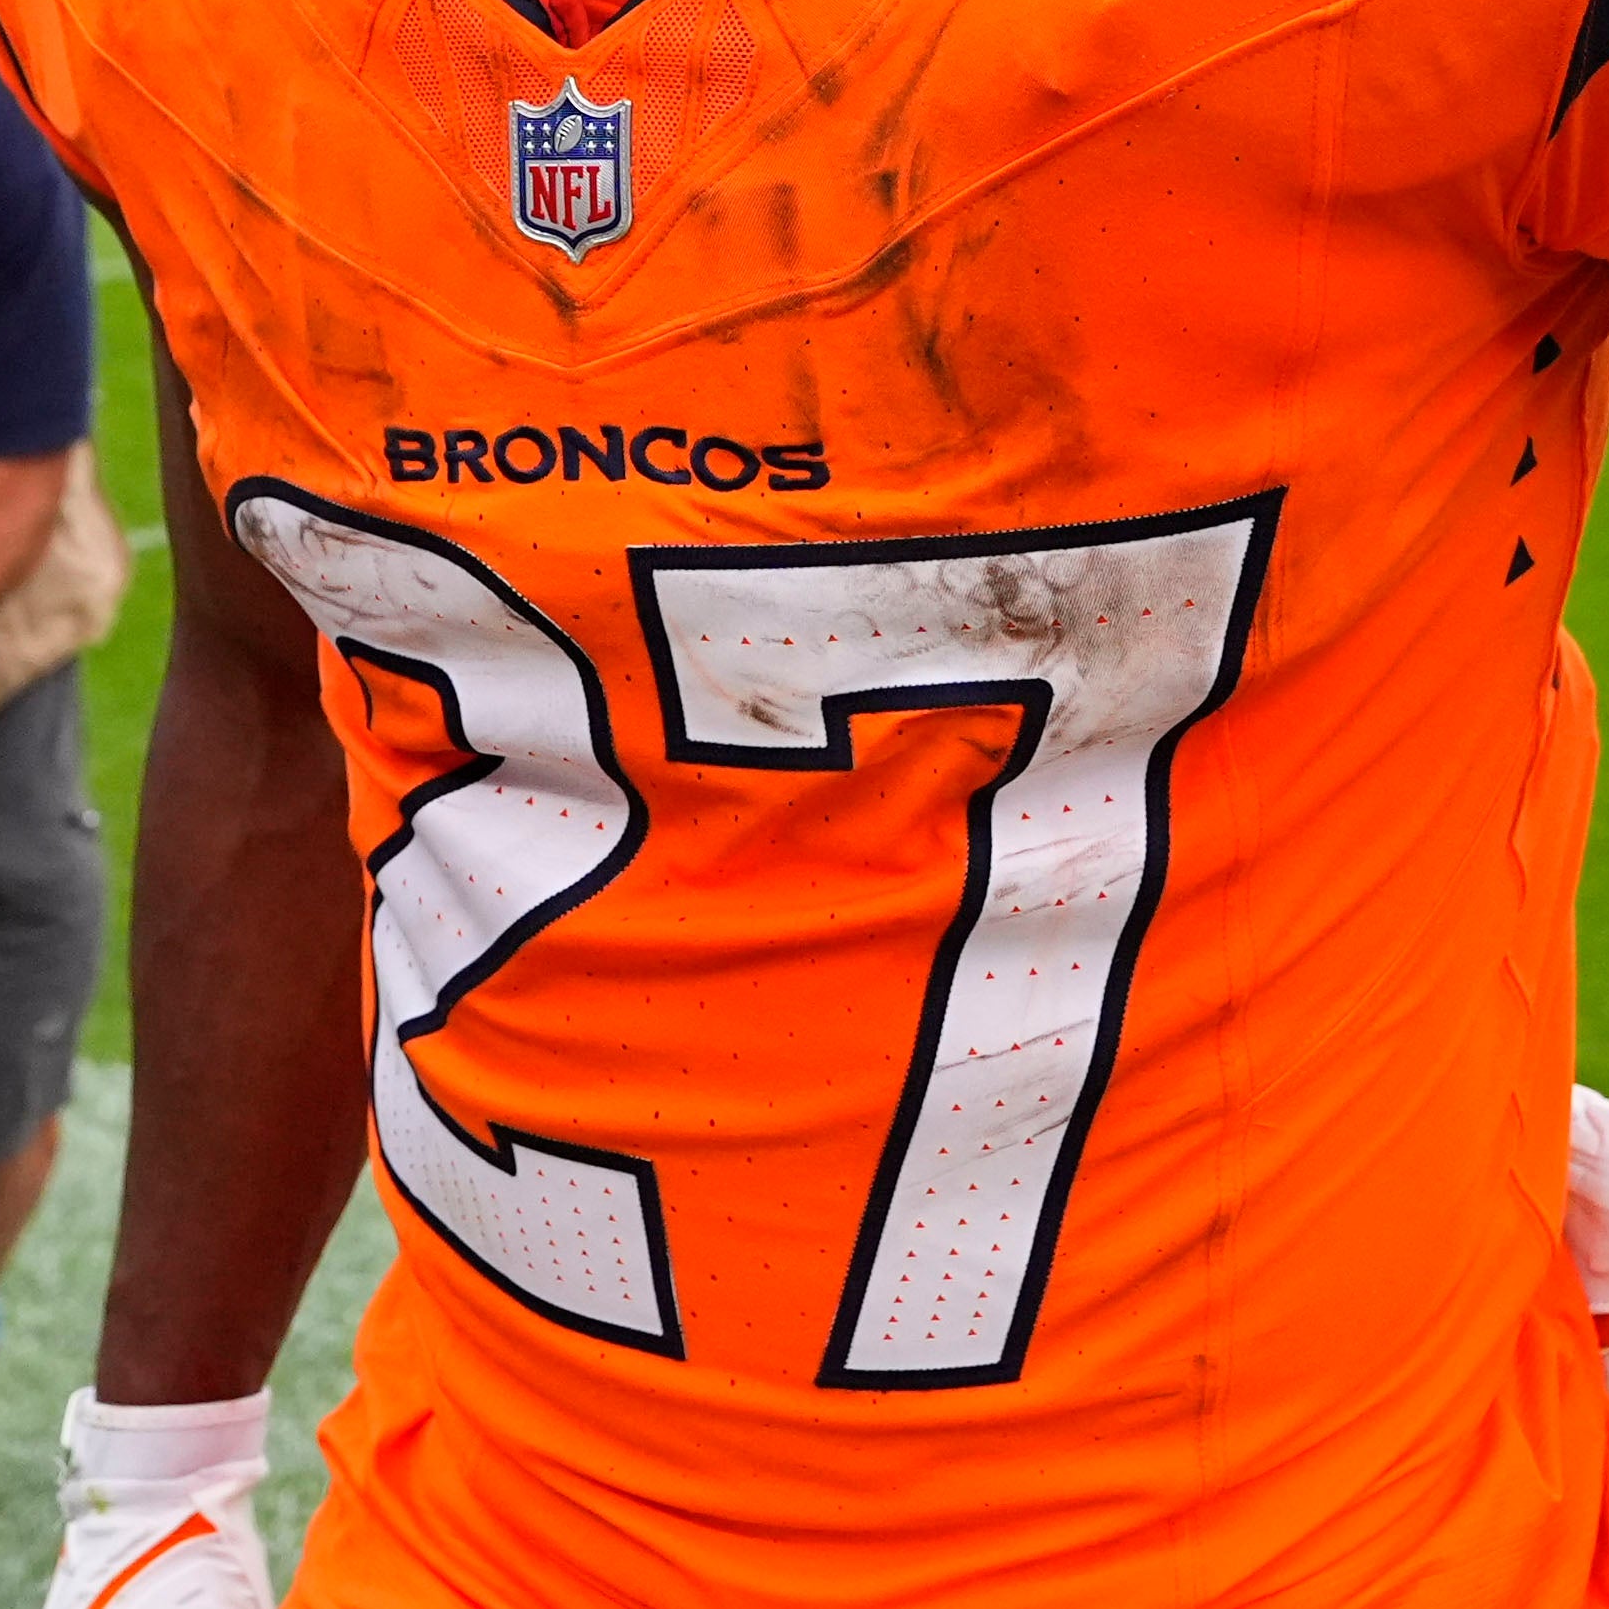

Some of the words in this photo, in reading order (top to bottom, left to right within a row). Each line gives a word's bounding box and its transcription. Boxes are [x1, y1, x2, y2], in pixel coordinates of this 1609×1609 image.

[529, 164, 612, 231] NFL
[384, 425, 831, 491] BRONCOS
[225, 476, 1288, 1389] 27
